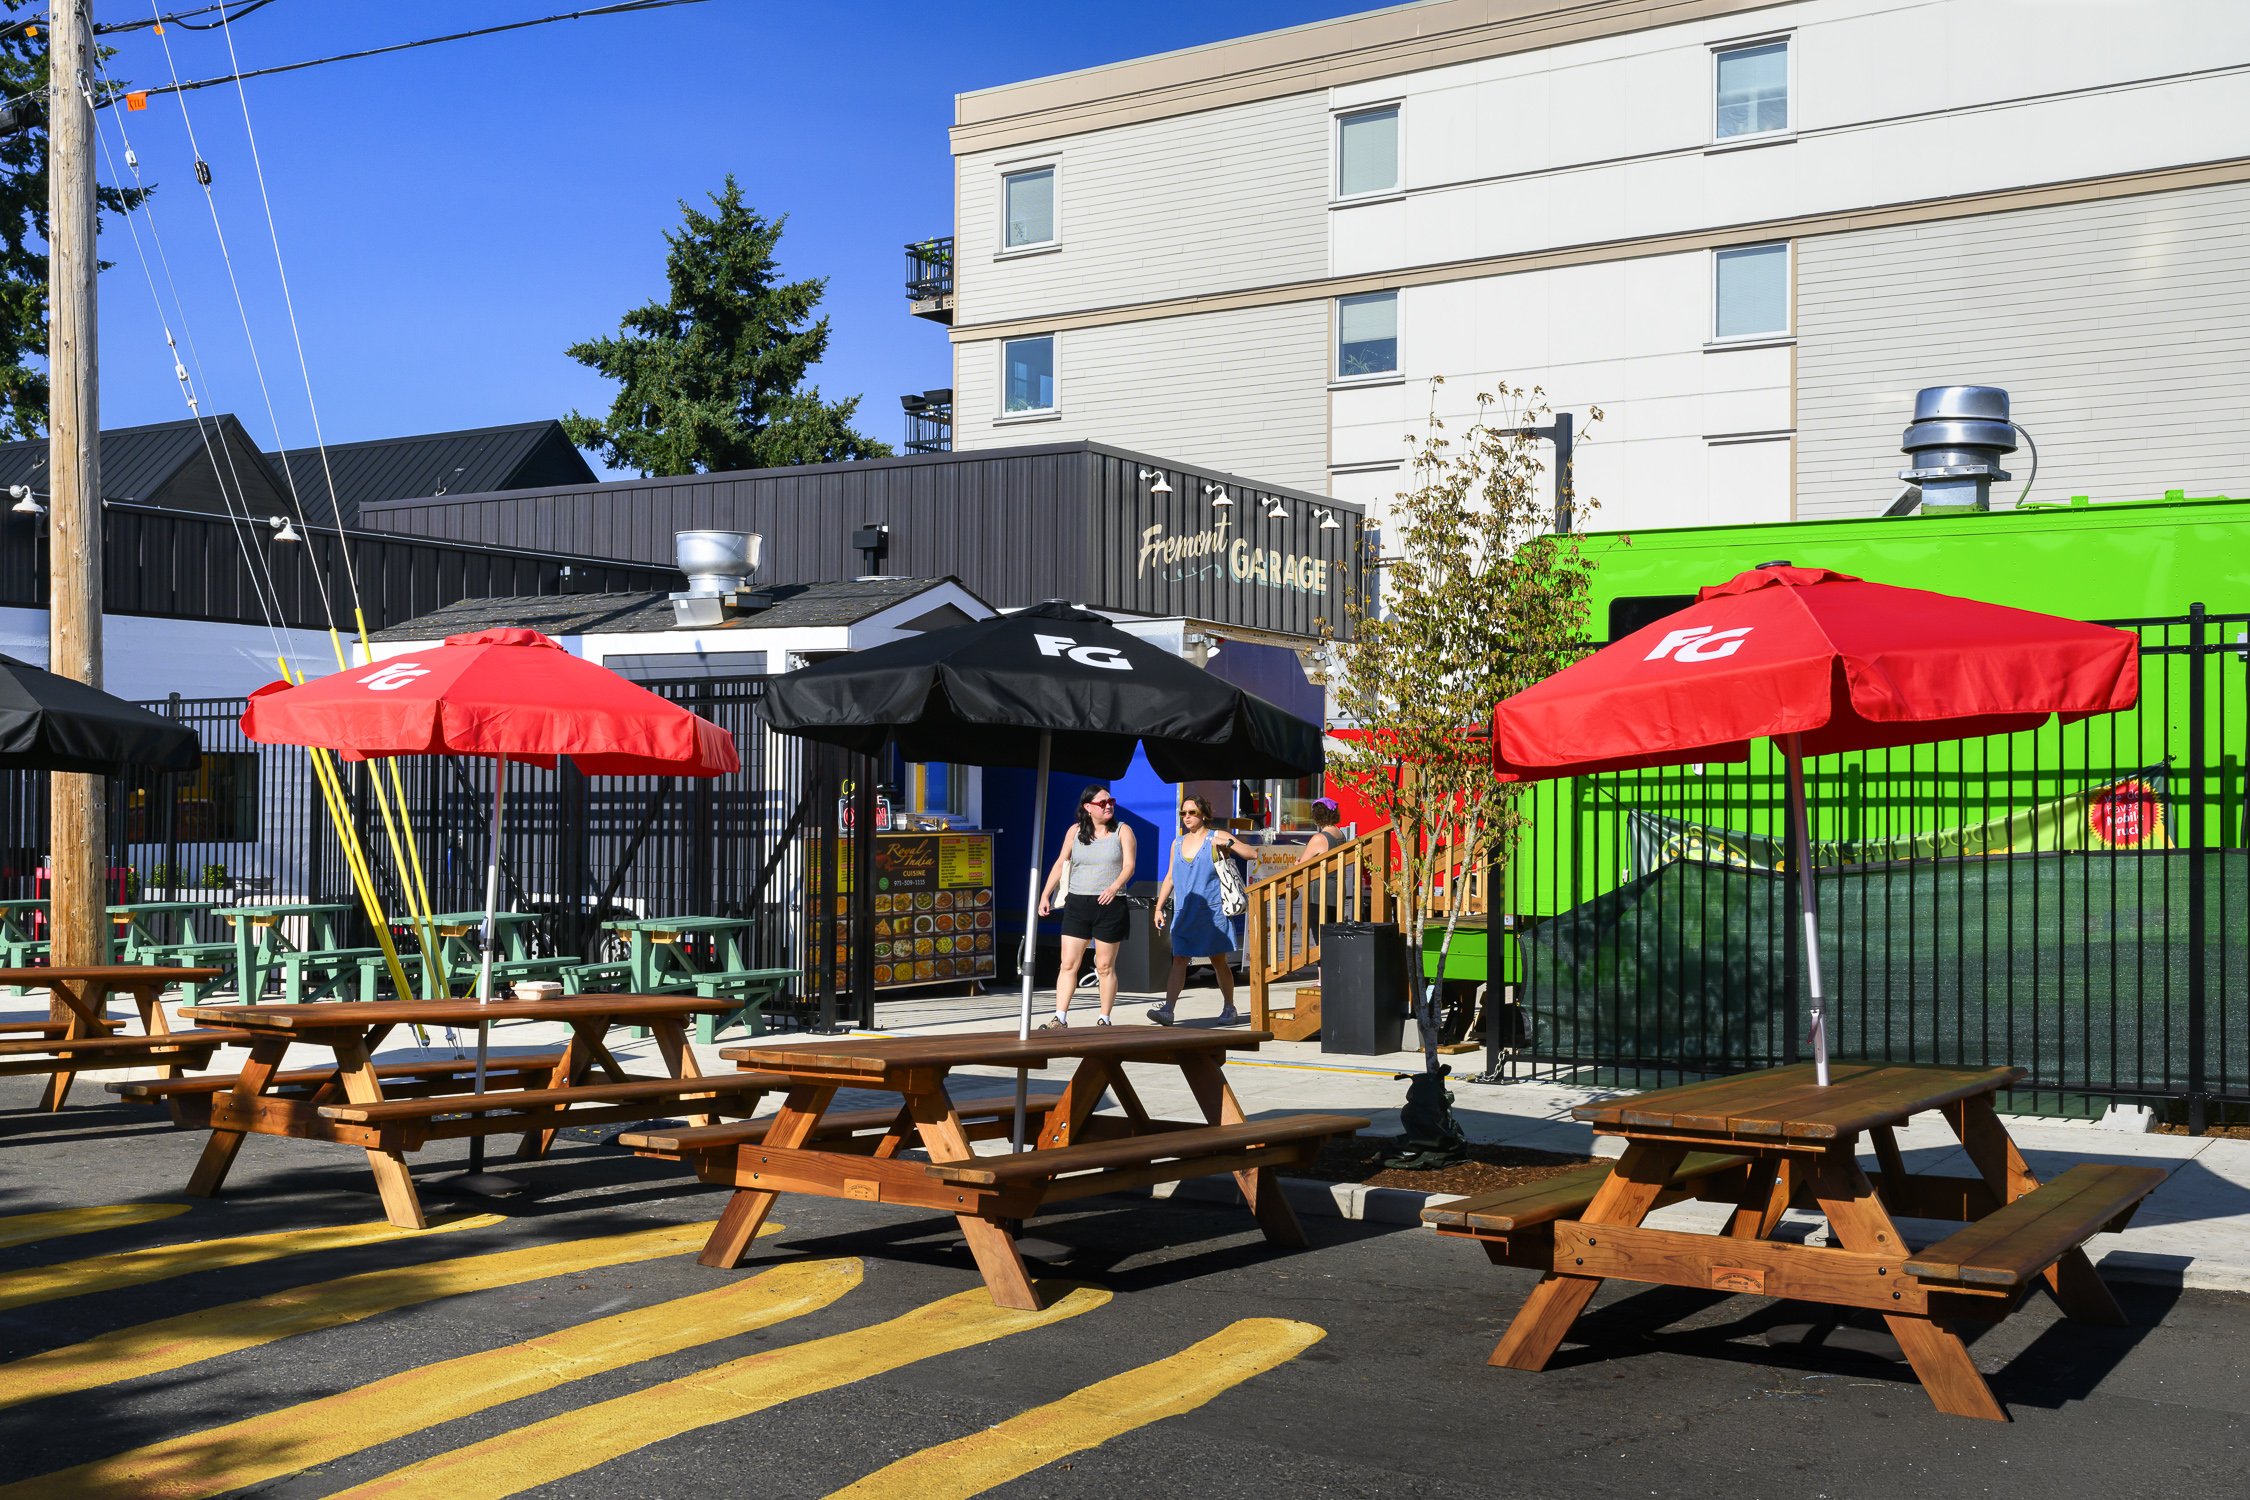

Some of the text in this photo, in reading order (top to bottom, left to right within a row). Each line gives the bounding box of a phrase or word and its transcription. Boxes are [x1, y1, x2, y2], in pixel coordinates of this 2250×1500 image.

[1138, 512, 1327, 594] Fremont GARAGE
[1033, 633, 1134, 670] FG
[1642, 625, 1754, 662] FG
[356, 663, 432, 691] FG
[2112, 823, 2141, 836] ruc
[886, 838, 929, 864] Royal
[904, 849, 935, 866] India
[902, 869, 926, 877] CUISINE
